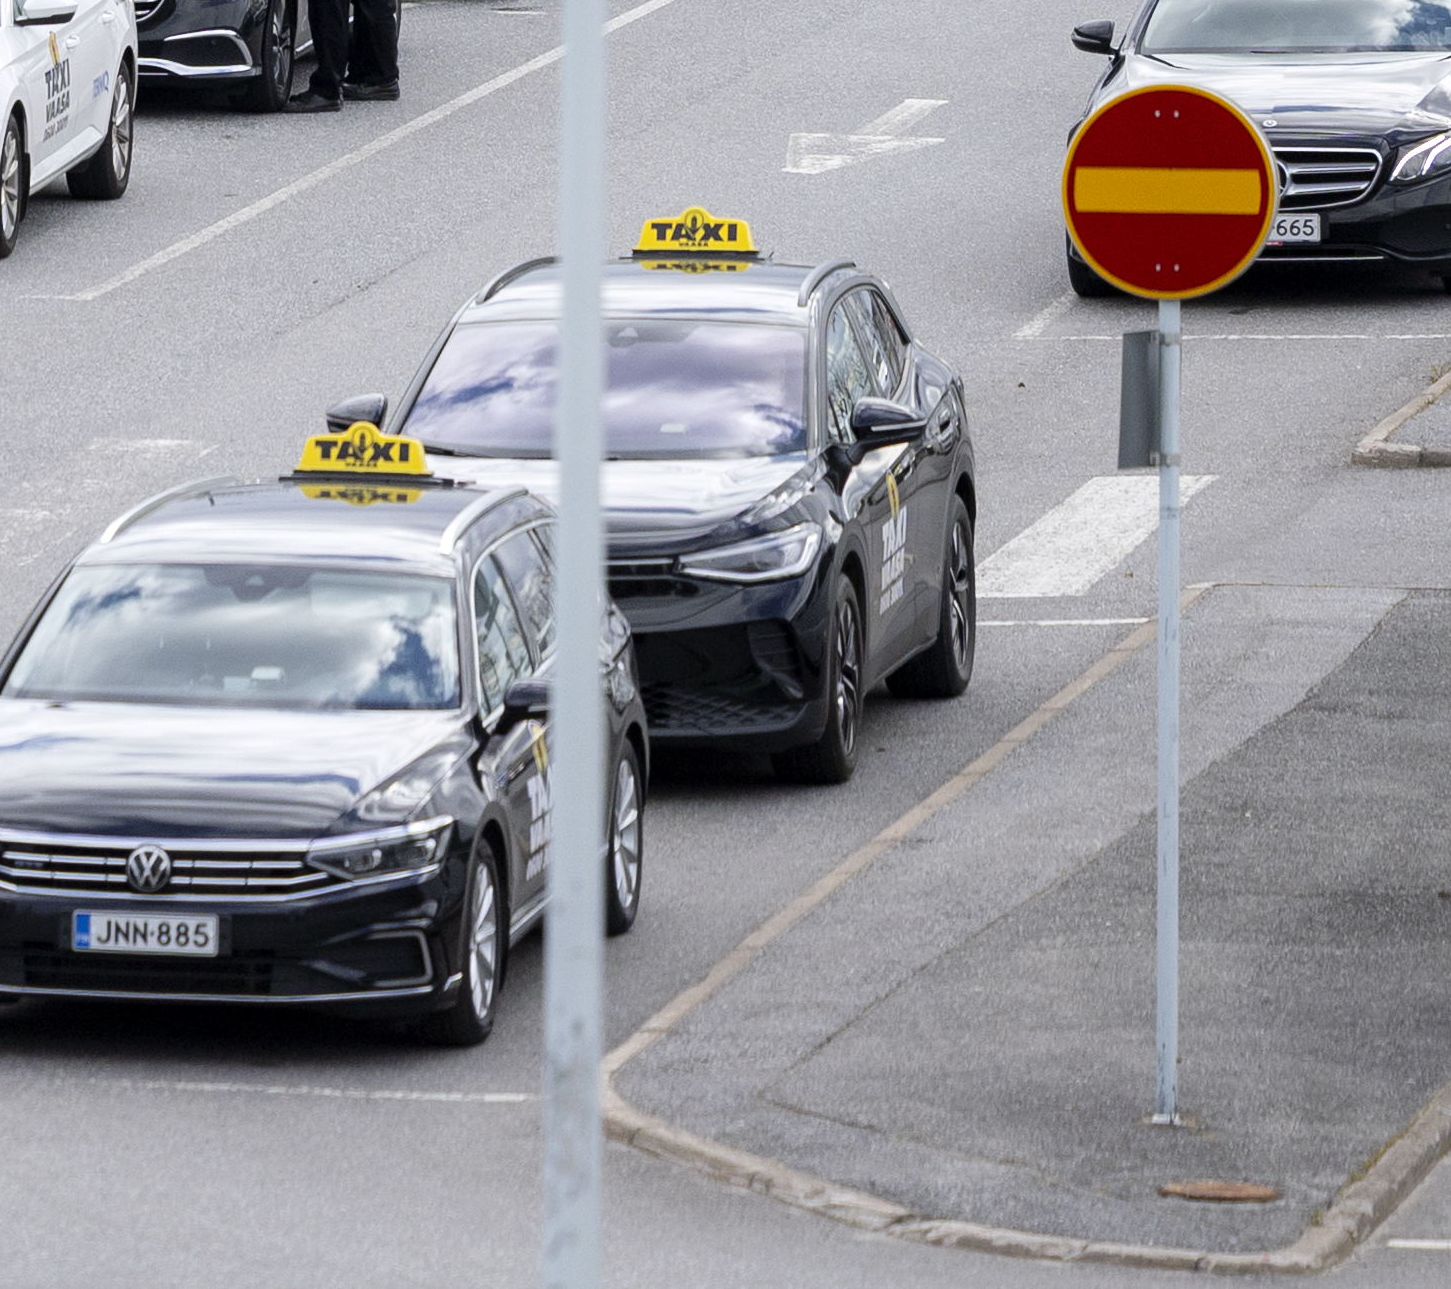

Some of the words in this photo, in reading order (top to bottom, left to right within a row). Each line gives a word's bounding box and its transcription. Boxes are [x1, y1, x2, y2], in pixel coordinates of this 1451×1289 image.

[45, 58, 70, 101] TAXI
[651, 222, 738, 241] TAXI
[315, 440, 410, 462] TAXI
[96, 918, 209, 948] JNN-885
